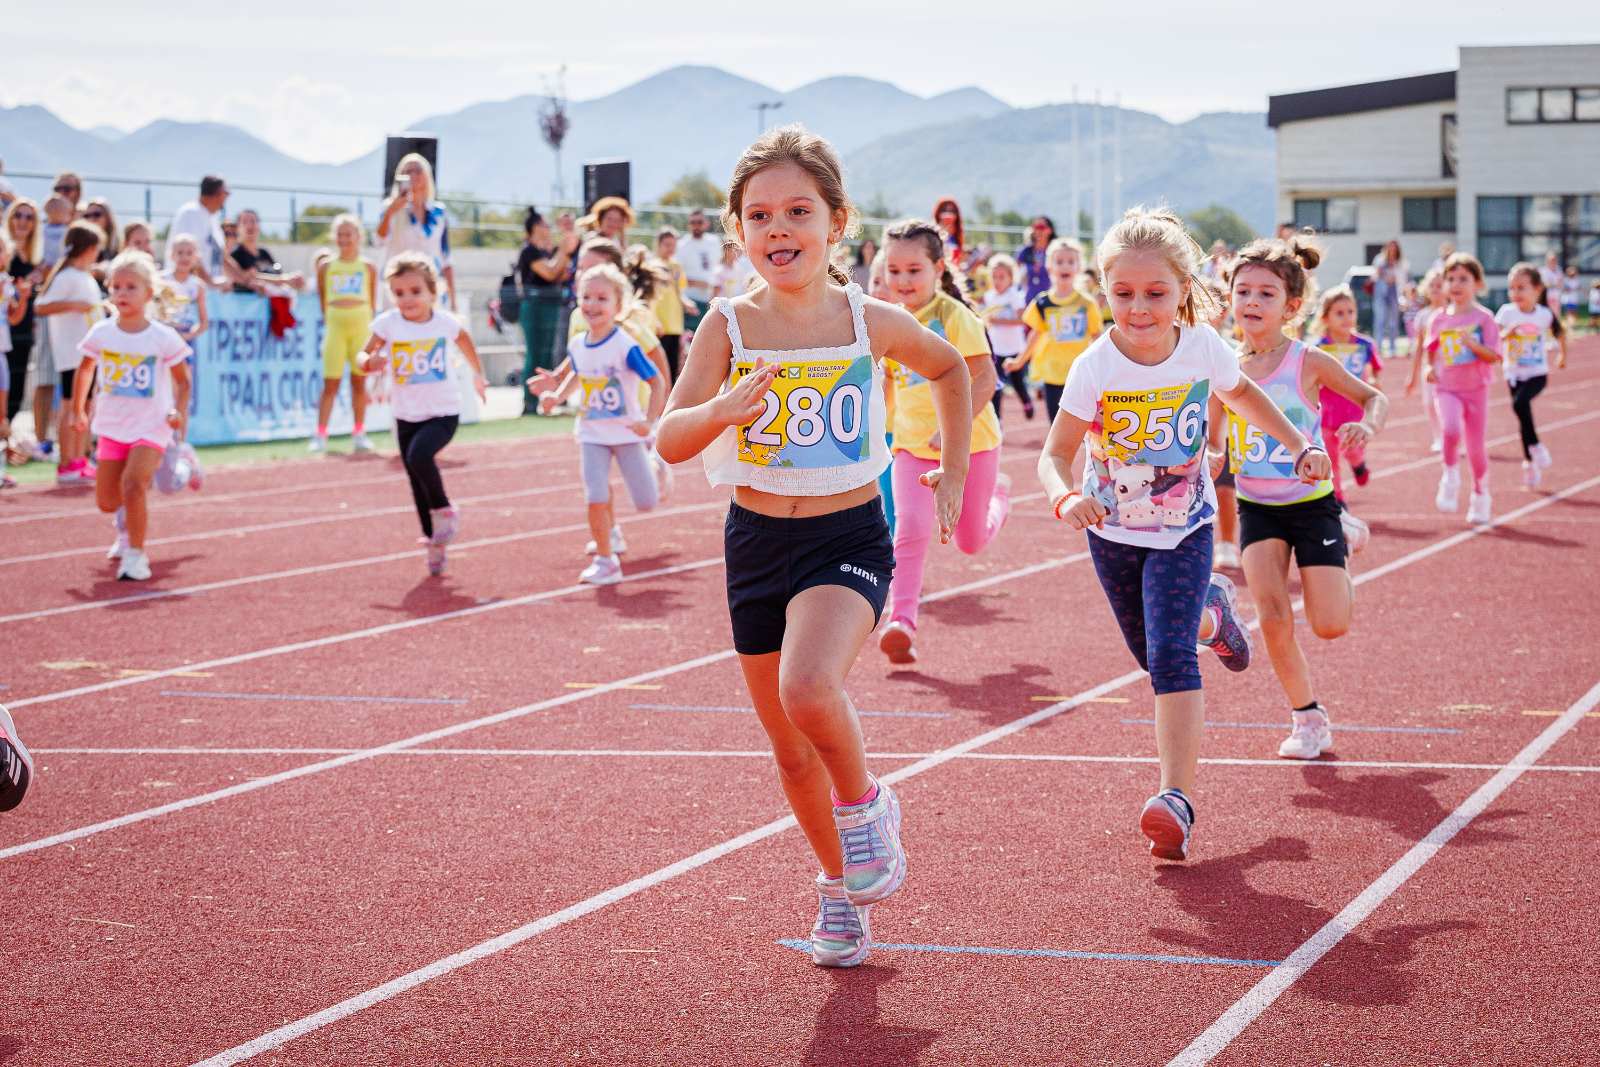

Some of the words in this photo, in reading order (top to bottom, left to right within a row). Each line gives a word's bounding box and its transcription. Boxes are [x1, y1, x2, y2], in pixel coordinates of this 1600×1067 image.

[101, 361, 150, 389] 239
[396, 348, 443, 375] 264
[220, 371, 276, 419] ГРАД
[278, 370, 322, 410] СПО
[1106, 394, 1146, 404] TROPIC
[747, 383, 864, 448] 280
[1110, 402, 1202, 451] 256
[852, 566, 878, 587] unit
